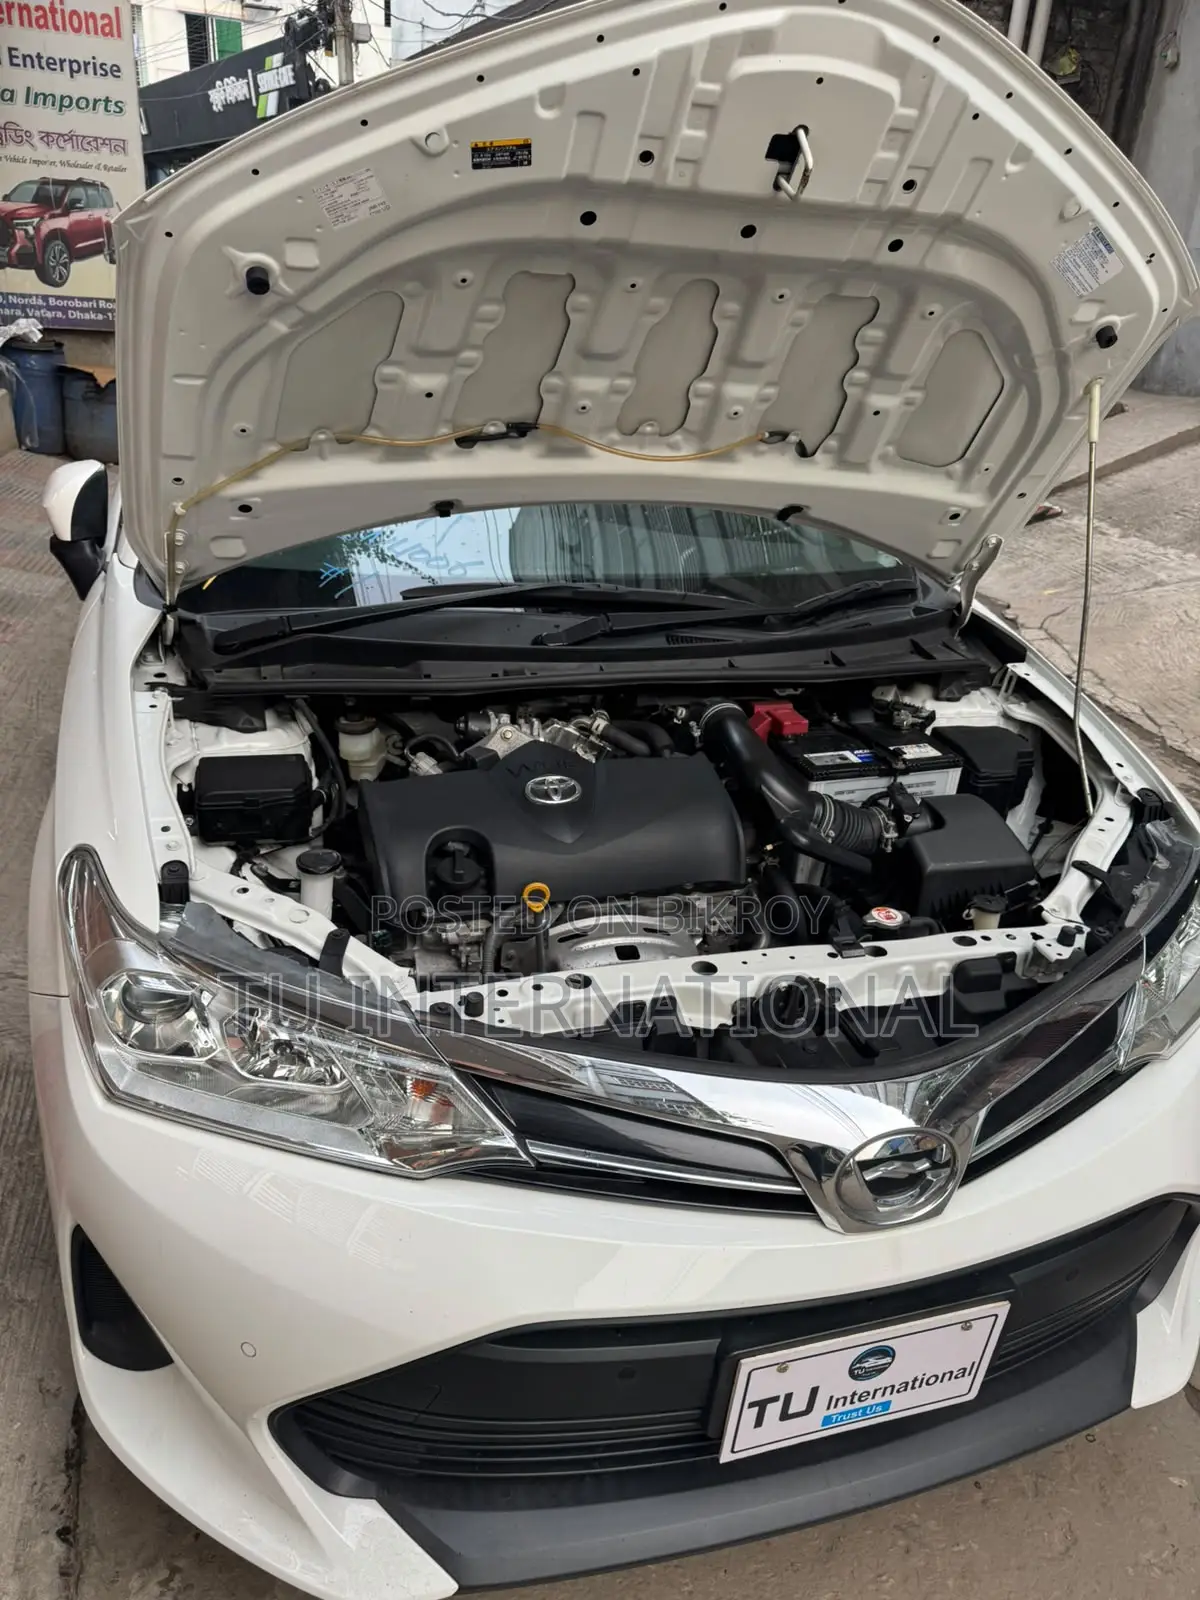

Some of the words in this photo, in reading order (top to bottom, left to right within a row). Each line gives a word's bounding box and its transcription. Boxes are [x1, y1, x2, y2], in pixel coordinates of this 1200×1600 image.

[8, 46, 121, 79] Enterprise
[24, 86, 125, 114] Imports
[4, 154, 28, 164] Vehicle
[29, 156, 58, 168] Imporer,
[48, 297, 97, 308] Borobari
[748, 1386, 820, 1429] TU
[826, 1361, 976, 1411] International
[831, 1407, 862, 1424] Trust
[866, 1404, 882, 1415] Us
